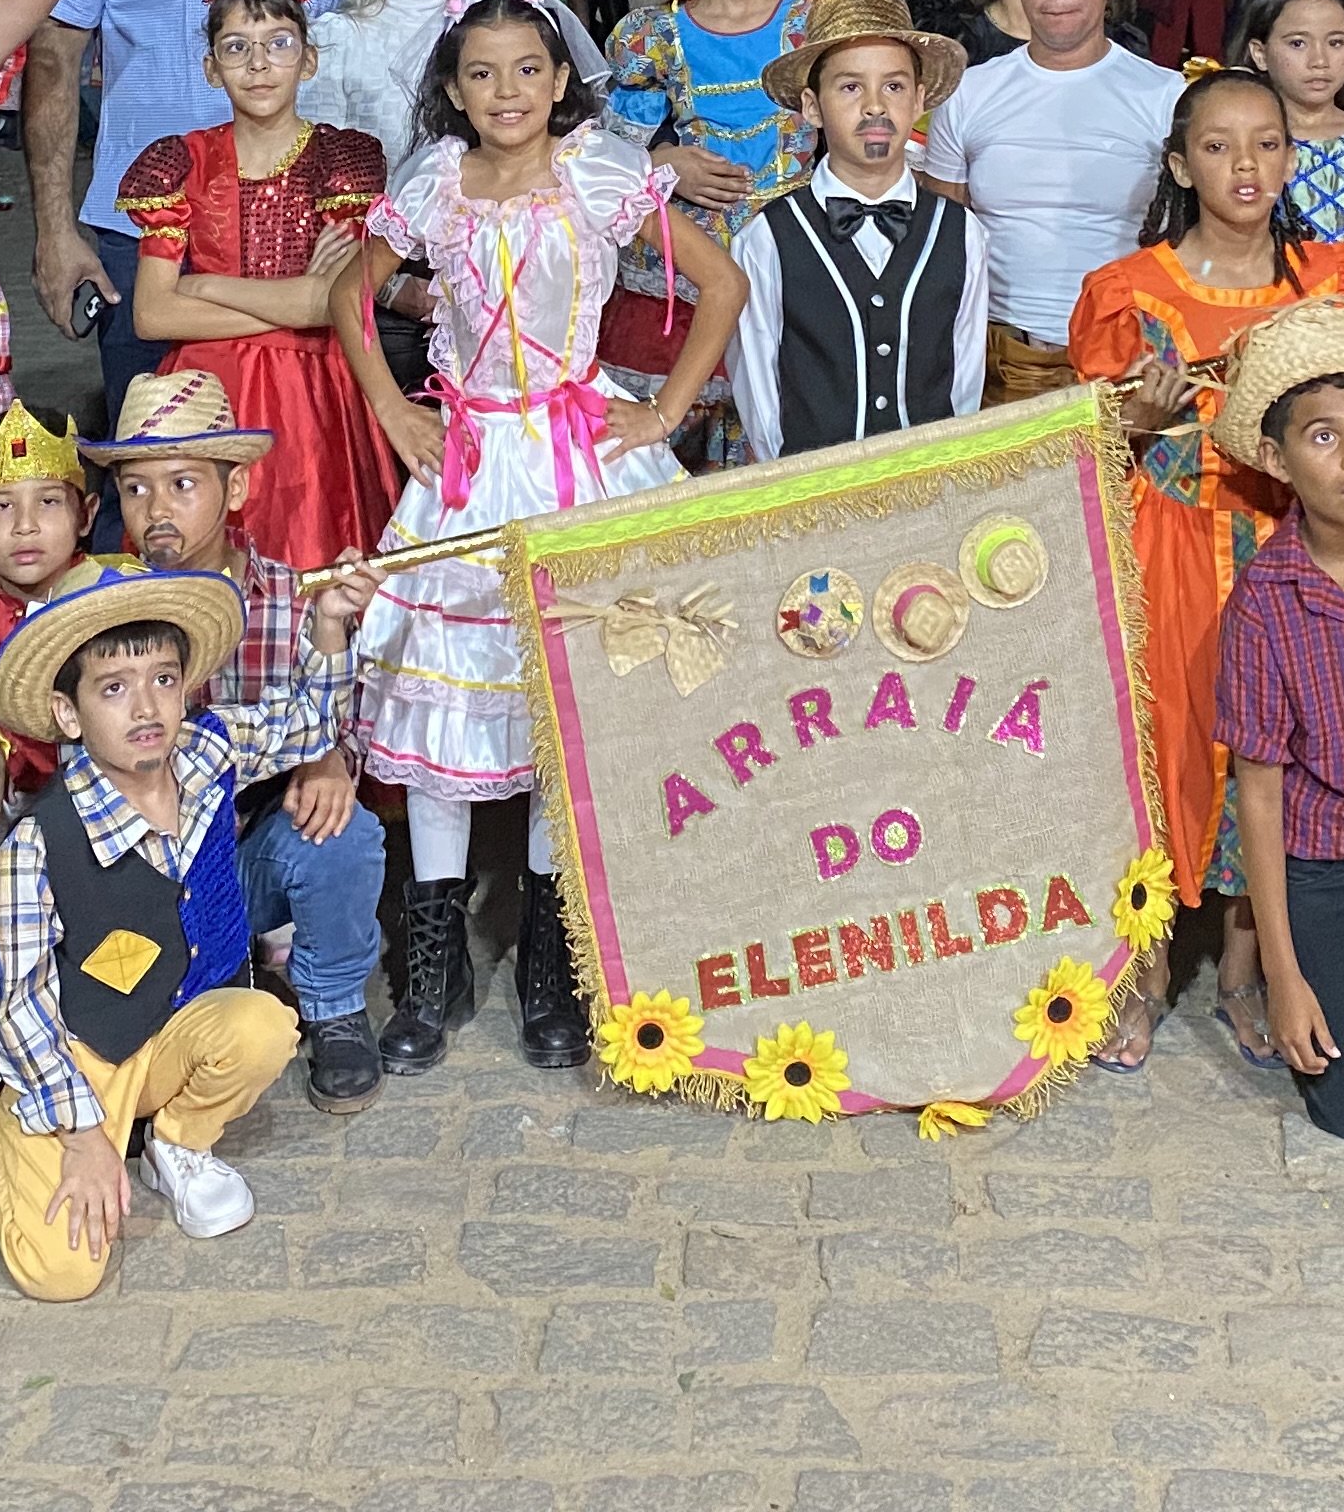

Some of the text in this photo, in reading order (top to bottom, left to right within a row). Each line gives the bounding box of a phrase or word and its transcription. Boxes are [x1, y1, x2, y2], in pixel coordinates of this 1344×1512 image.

[658, 670, 1050, 839] ARRAIÁ
[810, 807, 925, 881] DO
[693, 873, 1096, 1013] ELENILDA
